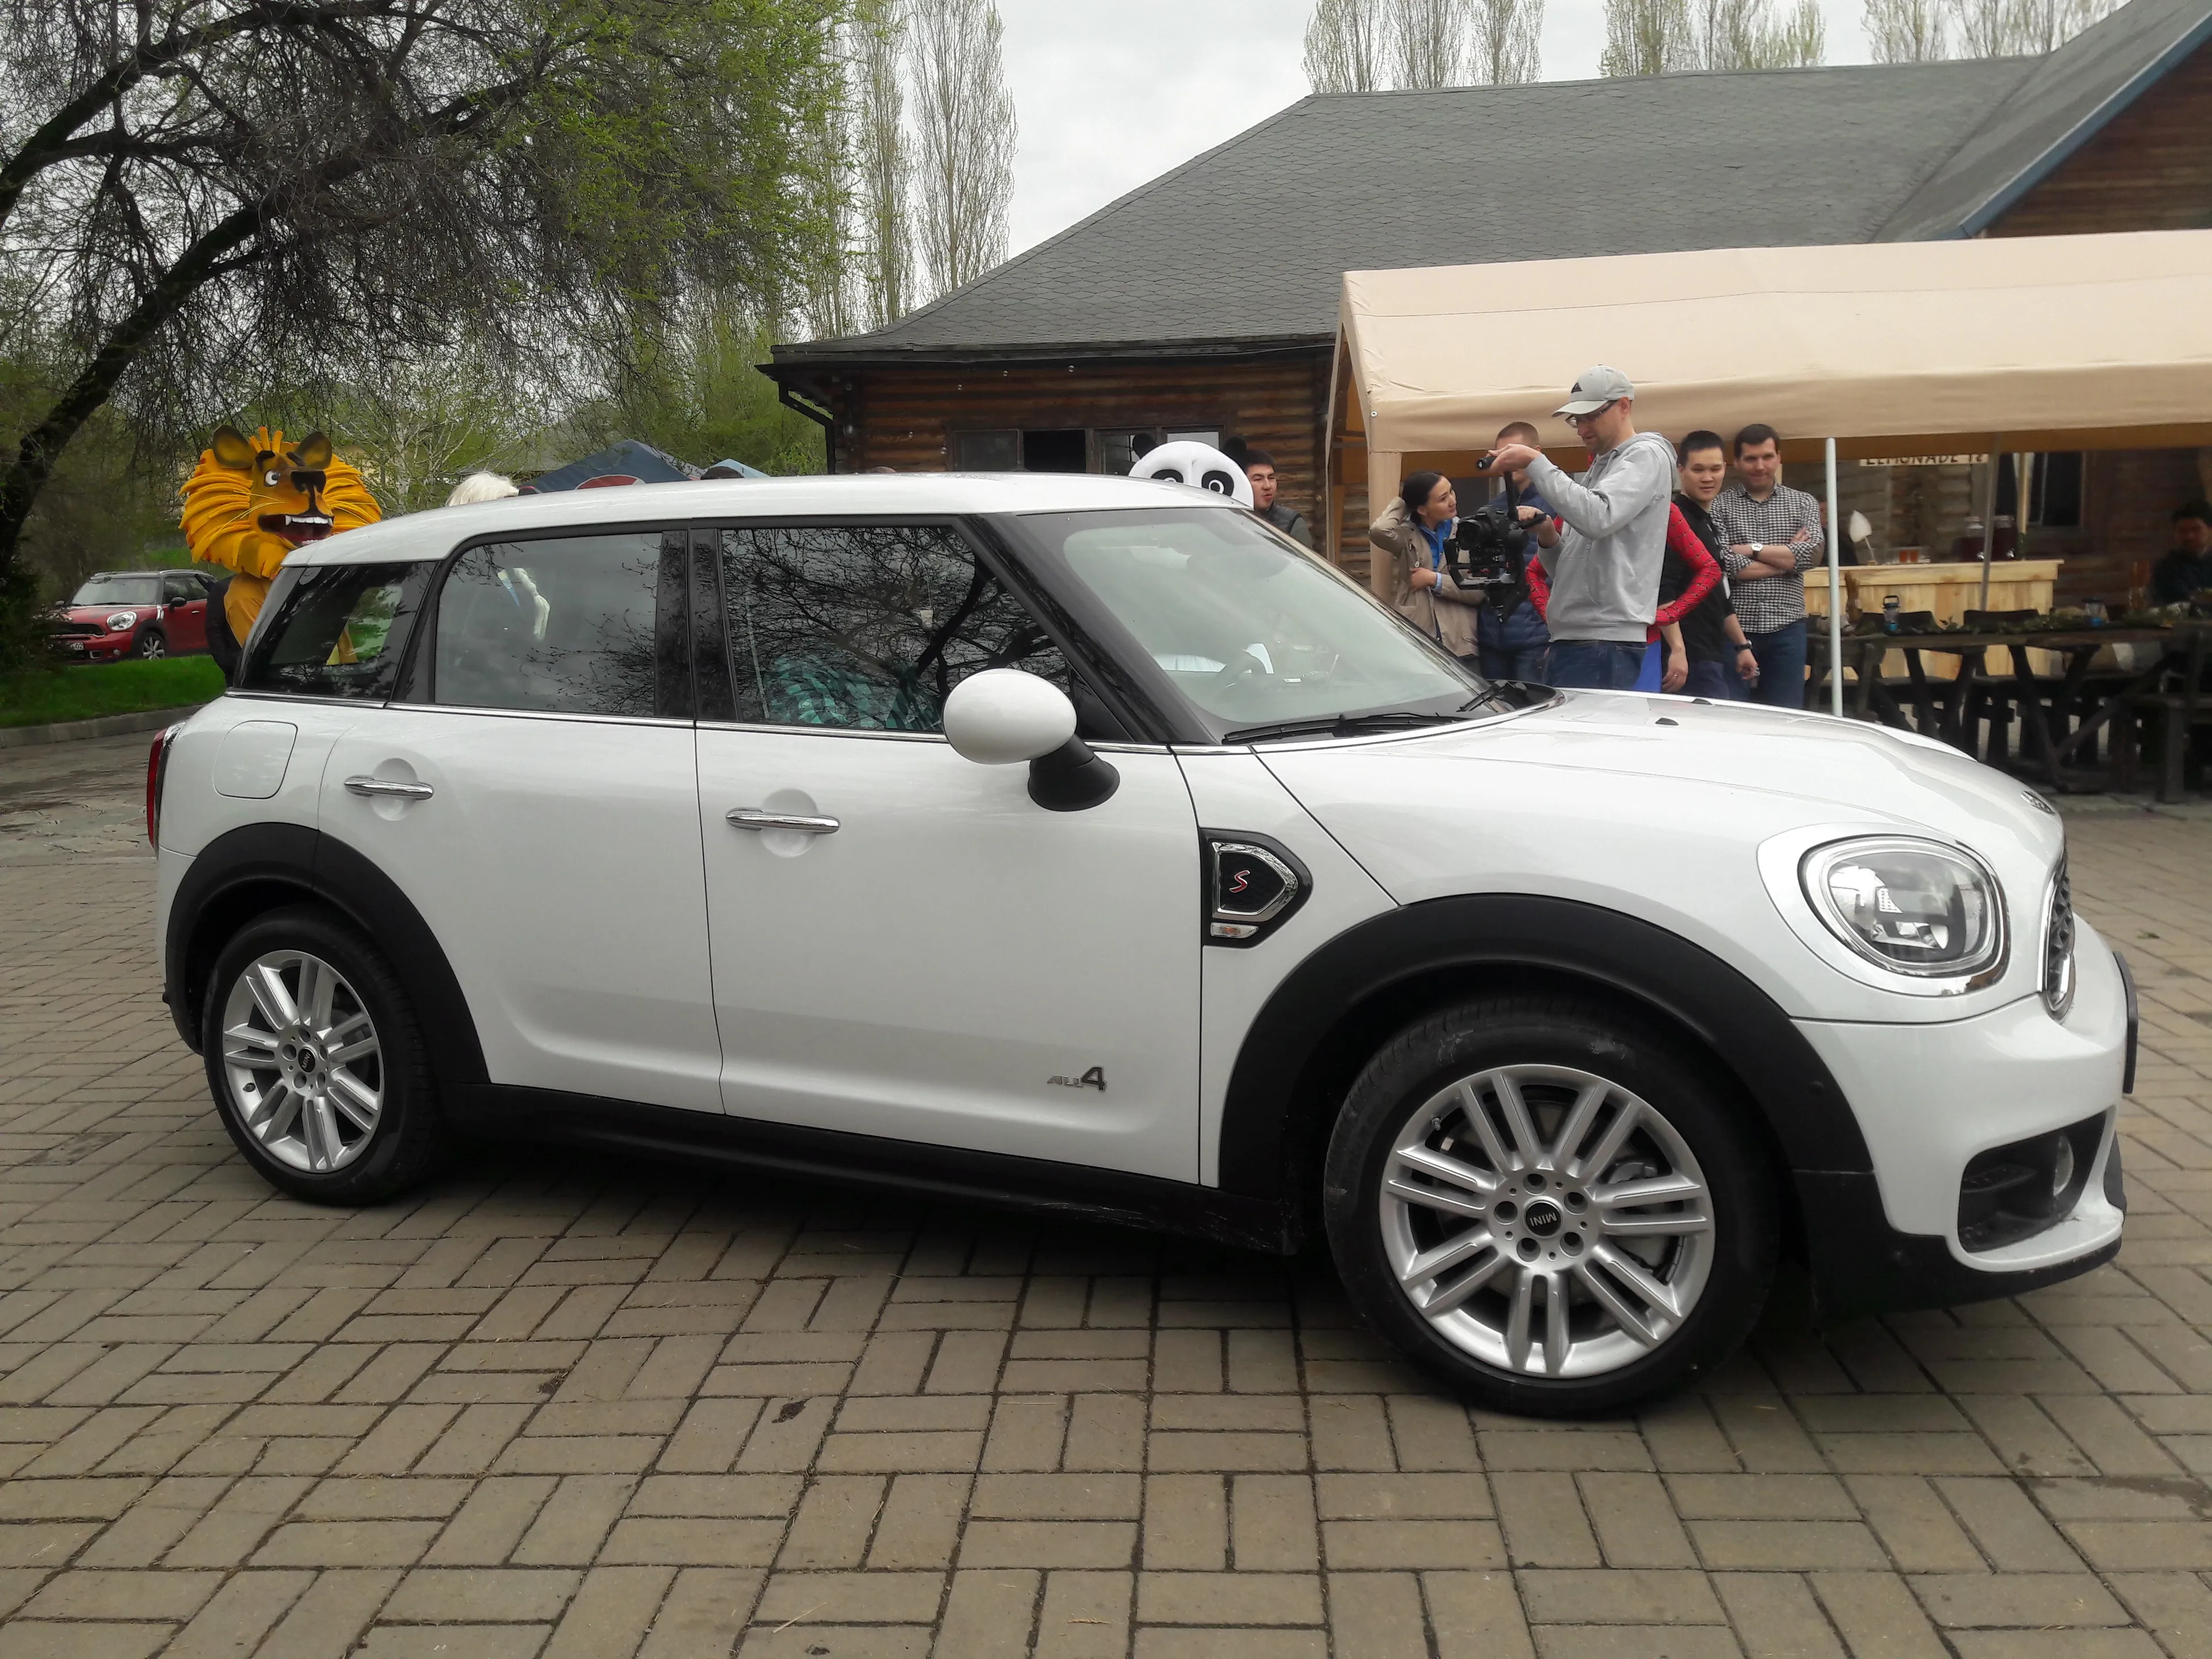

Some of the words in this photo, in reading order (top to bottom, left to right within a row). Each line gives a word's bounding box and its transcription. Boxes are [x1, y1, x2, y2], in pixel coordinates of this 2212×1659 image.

[1229, 870, 1251, 893] S
[301, 1051, 311, 1070] MINI
[1529, 1212, 1558, 1227] MINI
